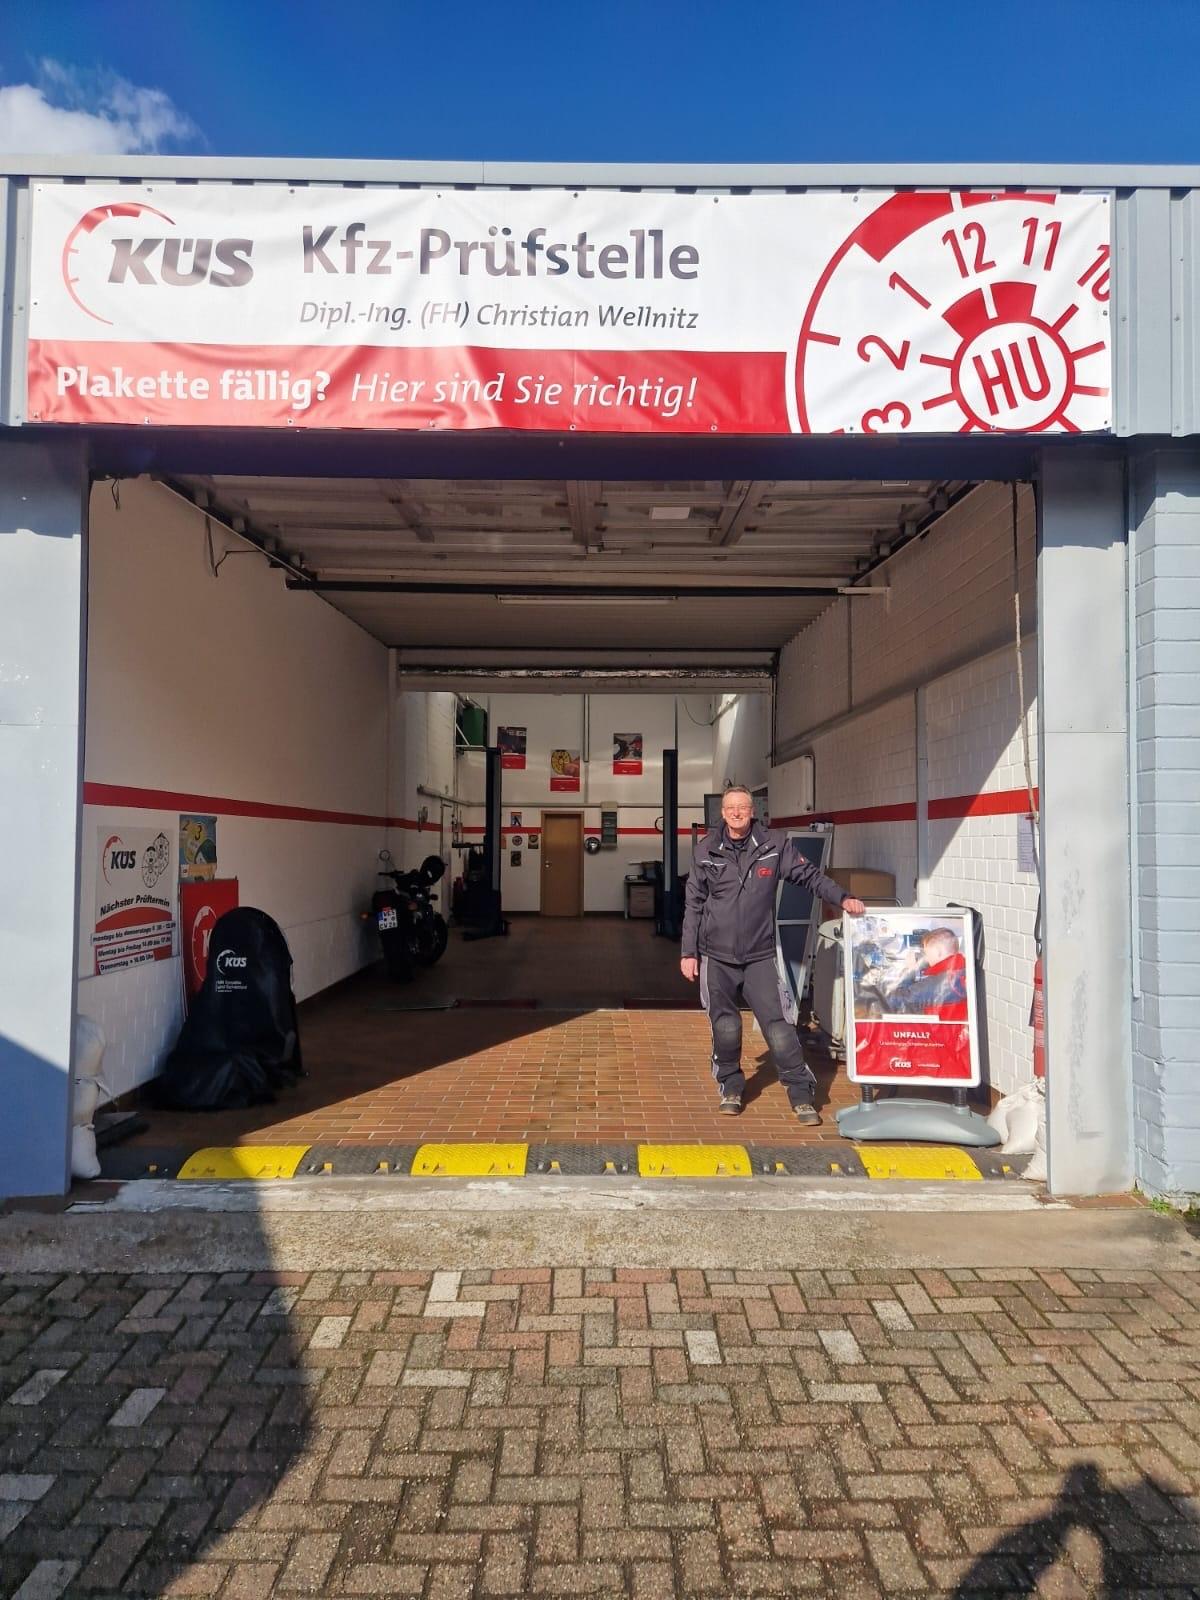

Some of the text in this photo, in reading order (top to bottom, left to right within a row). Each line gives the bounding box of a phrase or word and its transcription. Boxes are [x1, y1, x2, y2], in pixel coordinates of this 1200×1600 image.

[107, 238, 254, 287] KÜS
[302, 223, 700, 280] Kfz-Prüfstelle
[942, 221, 996, 278] 12
[1022, 217, 1062, 271] 11
[889, 271, 932, 309] 1
[300, 301, 699, 330] Dipl.-Ing. (FH) Christian Wellnitz
[857, 334, 911, 371] 2
[56, 366, 697, 418] Plakette fällig? Hier sind Sie richtig!
[973, 335, 1051, 416] HU
[861, 400, 912, 434] 3
[111, 850, 136, 869] KÜS
[100, 894, 171, 917] Nächster Prüftermin
[893, 1031, 930, 1039] UNFALL?
